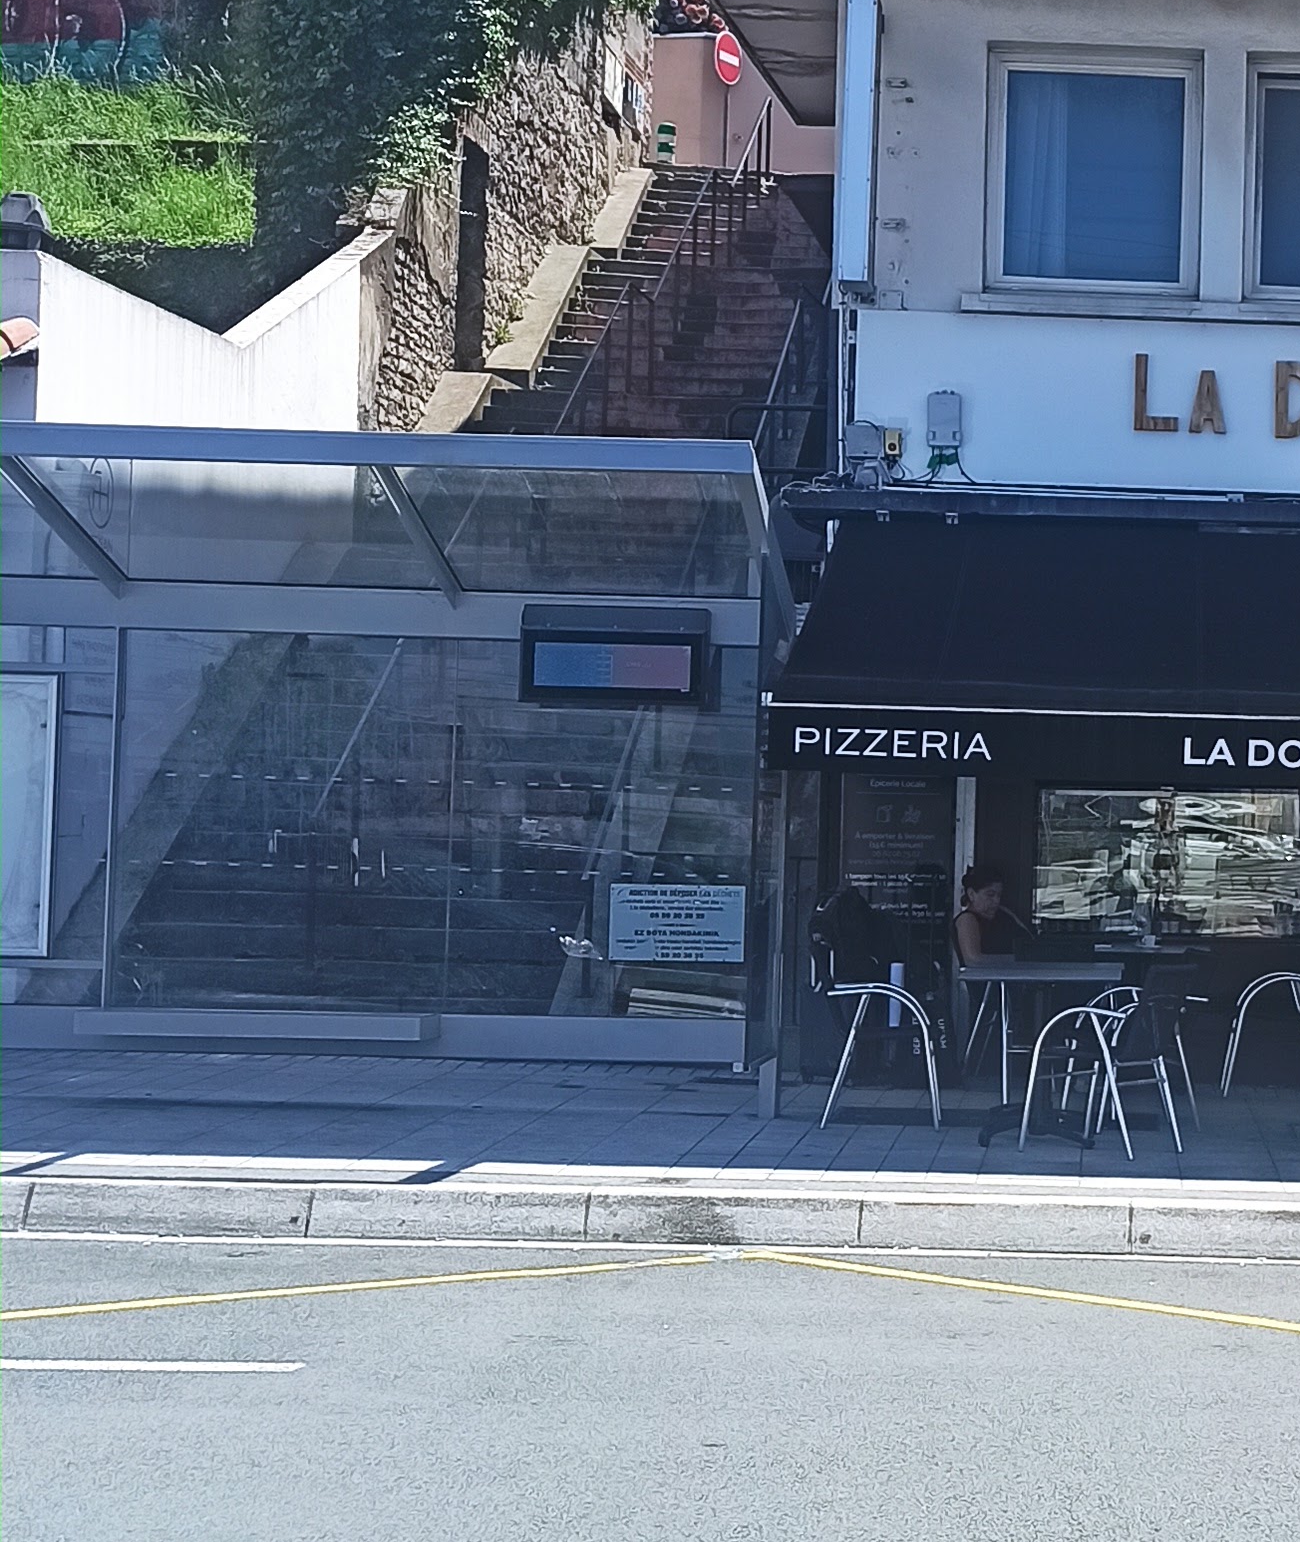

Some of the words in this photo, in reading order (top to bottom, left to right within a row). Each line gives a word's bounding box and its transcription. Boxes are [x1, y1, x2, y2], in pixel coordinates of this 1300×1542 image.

[1133, 353, 1227, 434] LA
[793, 726, 992, 761] PIZZERIA
[1183, 737, 1235, 767] LA
